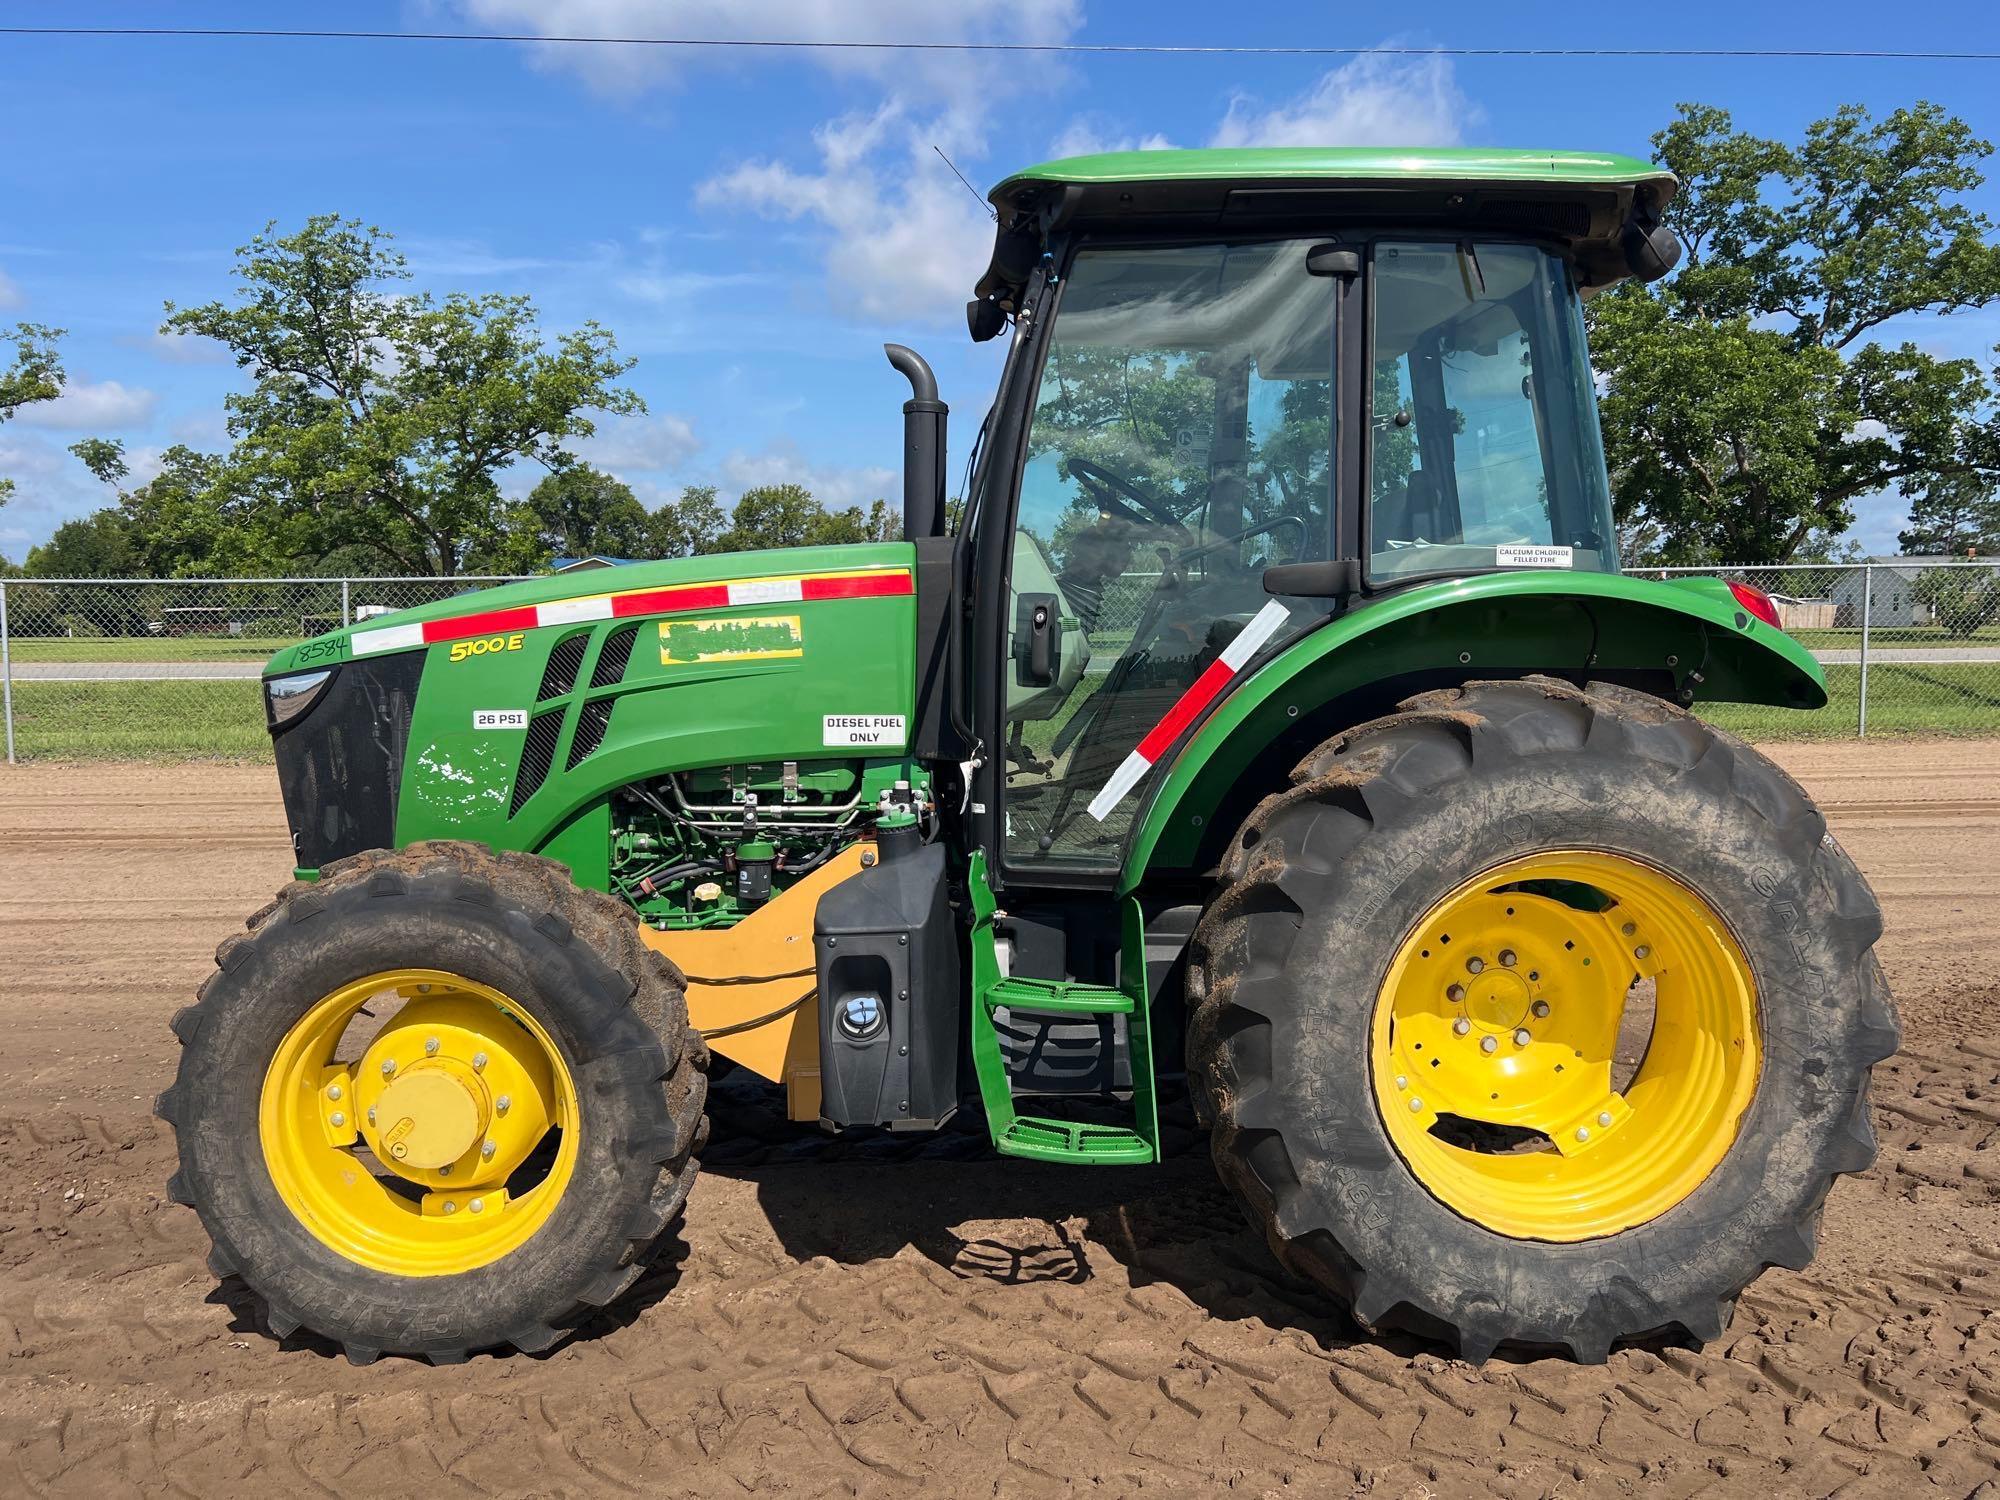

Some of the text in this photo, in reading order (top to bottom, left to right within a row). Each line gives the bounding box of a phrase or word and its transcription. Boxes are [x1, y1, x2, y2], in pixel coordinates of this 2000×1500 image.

[290, 635, 348, 668] 18584
[478, 714, 523, 724] 26 PSI
[827, 718, 902, 728] DIESEL FUEL
[849, 732, 880, 742] ONLY
